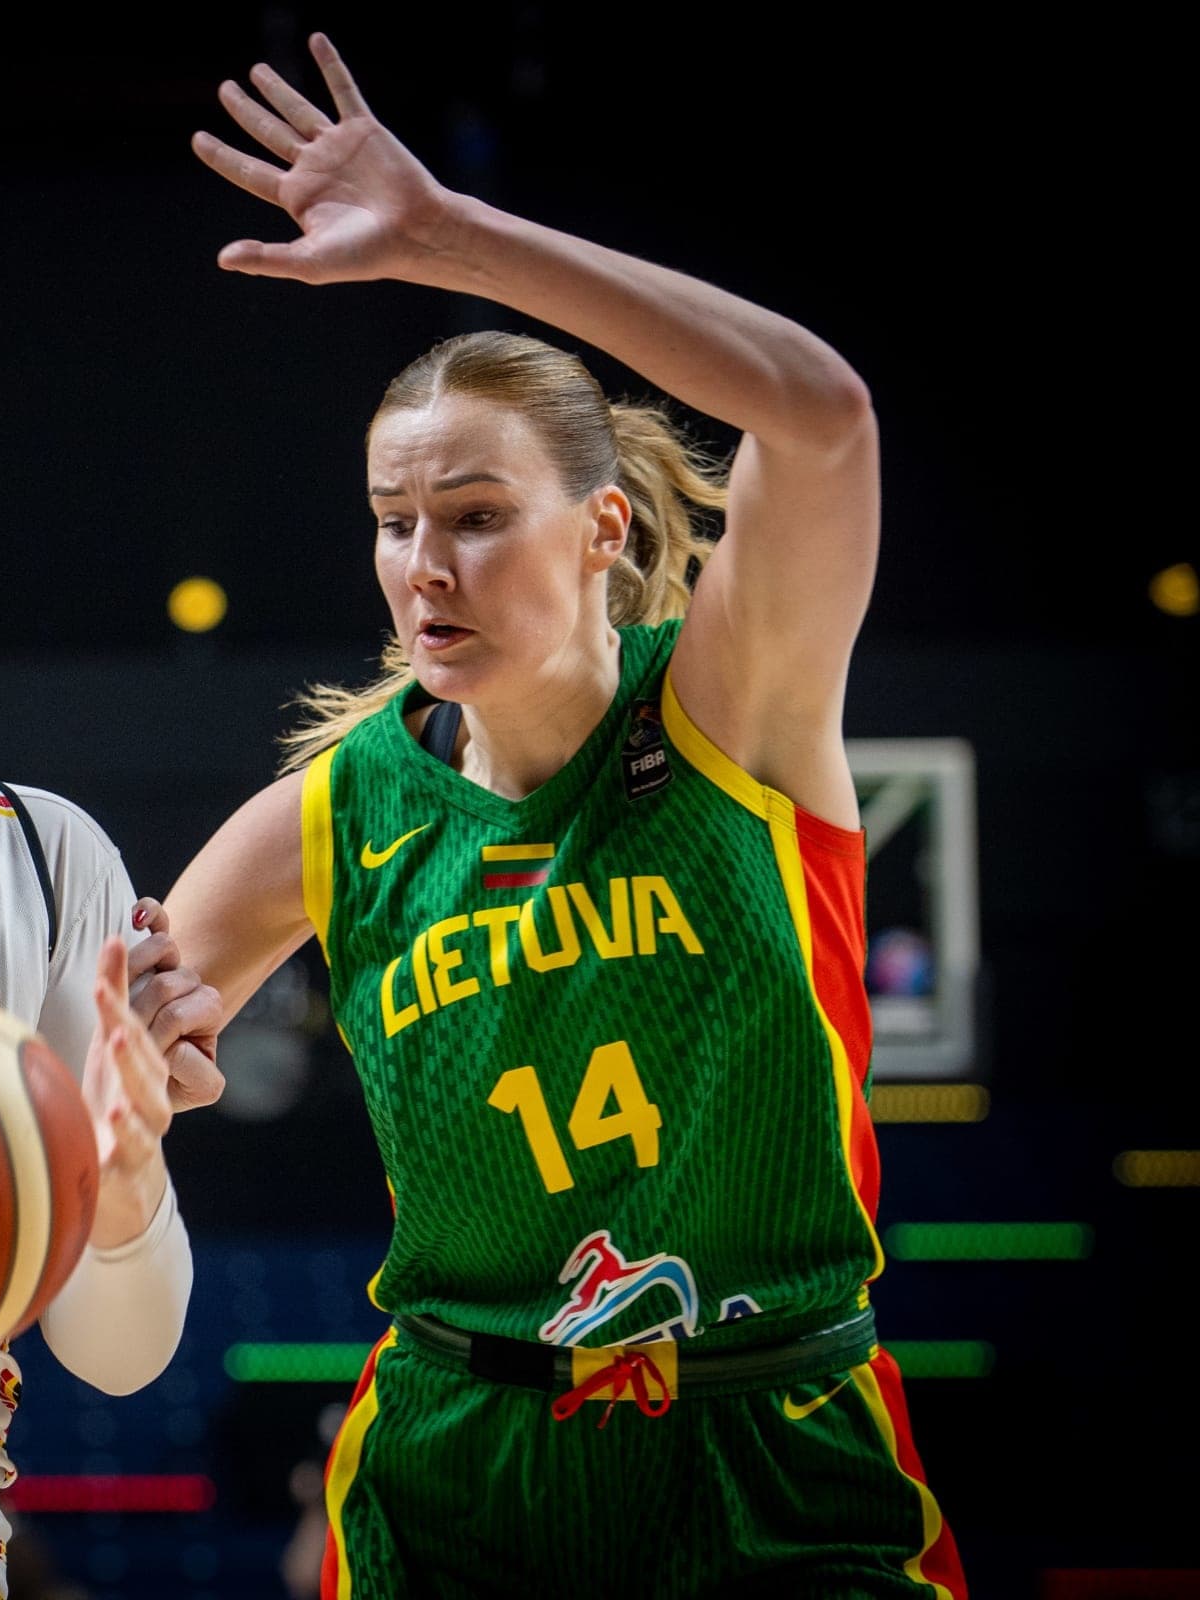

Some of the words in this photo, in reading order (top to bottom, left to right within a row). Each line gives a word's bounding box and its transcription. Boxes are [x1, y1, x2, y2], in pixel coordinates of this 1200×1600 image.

[630, 749, 666, 776] FIBA
[380, 874, 705, 1038] LIETUVA
[486, 1040, 663, 1195] 14
